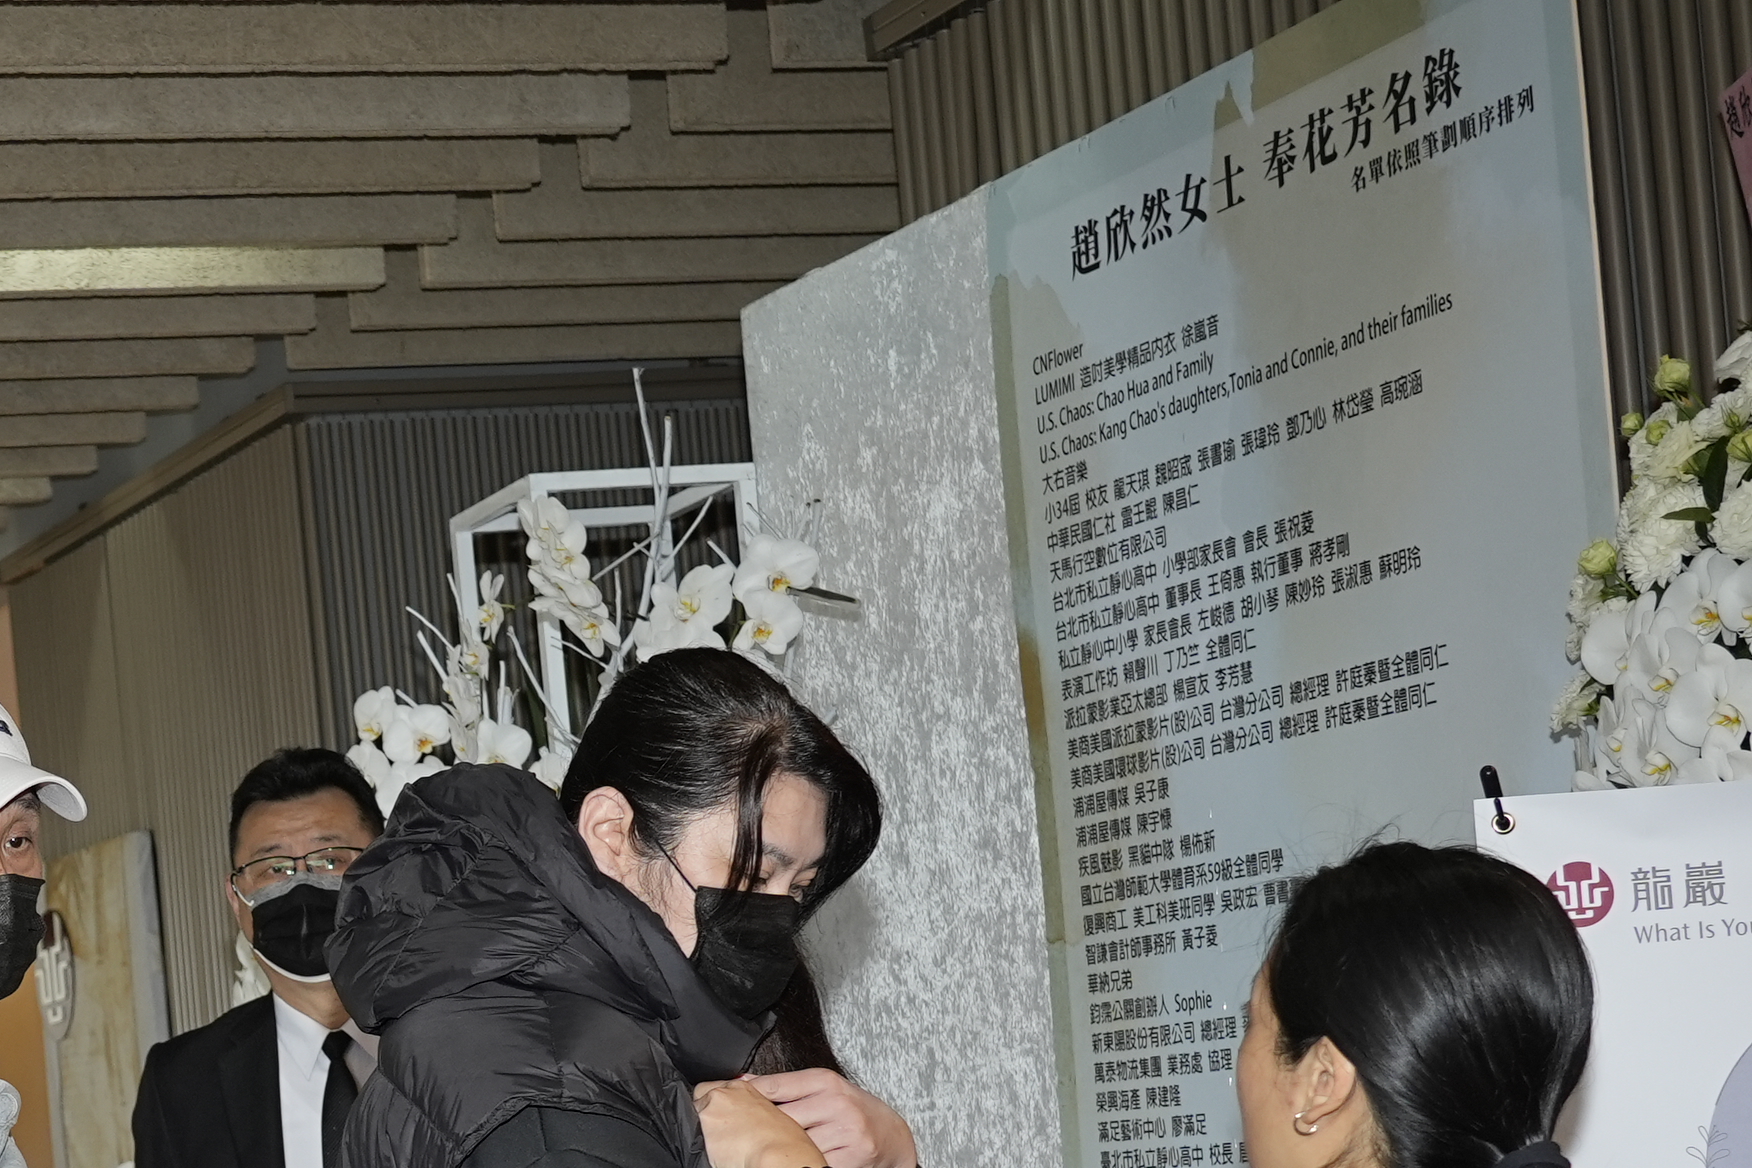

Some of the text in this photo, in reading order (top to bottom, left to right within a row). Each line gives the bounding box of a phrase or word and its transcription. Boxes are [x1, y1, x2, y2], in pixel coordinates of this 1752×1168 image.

[1070, 47, 1462, 280] 趙欣然女士 奉花芳名錄
[1351, 84, 1534, 192] 名單依照筆劃順序排列
[1032, 343, 1083, 375] CNFlower
[1039, 441, 1060, 464] U.S.
[1061, 431, 1097, 455] Chaos:
[1098, 419, 1127, 442] Kang
[1128, 400, 1166, 430] Chao's
[1265, 351, 1288, 380] and
[1290, 337, 1338, 369] Connie,
[1340, 321, 1364, 350] and
[1366, 311, 1398, 340] their
[1400, 292, 1452, 327] families
[1034, 372, 1075, 405] LUMIMI
[1036, 350, 1213, 434] U.S. Chaos: Chao Hua and Family
[1044, 492, 1080, 524] 小34屆
[1084, 484, 1109, 510] 校友
[1112, 467, 1150, 500] 龍天琪
[1196, 437, 1235, 471] 張書瑜
[1285, 405, 1326, 441] 鄧乃心
[1046, 511, 1116, 553] 中華民國仁社
[1162, 483, 1200, 515] 陳昌仁
[1049, 525, 1167, 583] 天馬行空數位有限公司
[1052, 509, 1314, 612] 台北市私立靜心高中 小學部家長會 會長 張祝菱
[1055, 592, 1159, 642] 台北市私立靜心高中
[1164, 577, 1202, 609] 董事長
[1250, 546, 1303, 584] 執行董事
[1057, 627, 1138, 671] 私立靜心中小學
[1143, 612, 1192, 646] 家長會長
[1239, 586, 1279, 619] 胡小琴
[1284, 573, 1325, 607] 陳妙玲
[1330, 559, 1373, 593] 張淑惠
[1378, 545, 1421, 580] 蘇明玲
[1060, 627, 1256, 701] 表演工作坊 賴聲川 丁乃竺 全體同仁
[1063, 660, 1253, 729] 派拉蒙影業亞太總部 楊宣友 李芳慧
[1066, 702, 1214, 760] 美商美國派拉蒙影片(股)公司
[1219, 684, 1284, 722] 台灣分公司
[1289, 672, 1330, 704] 總經理
[1070, 736, 1205, 789] 美商美國環球影片(股)公司
[1209, 719, 1273, 756] 台灣分公司
[1278, 708, 1319, 740] 總經理
[1072, 776, 1169, 818] 浦浦屋傳媒 吳子康
[1075, 815, 1132, 847] 浦浦屋傳媒
[1127, 838, 1174, 867] 黑貓中隊
[1080, 847, 1283, 906] 國立台灣師範大學體育系59級全體同學
[1630, 861, 1729, 912] 龍巖
[1082, 879, 1298, 936] 復興商工 美工科美班同學 吳政宏 曹書
[1633, 918, 1752, 943] What Is Yo
[1181, 924, 1218, 951] 黃子菱
[1086, 968, 1132, 994] 華納兄弟
[1174, 989, 1212, 1016] Sophie
[1091, 1021, 1195, 1054] 新東陽股份有限公司
[1200, 1015, 1237, 1041] 總經理
[1093, 1047, 1233, 1083] 萬泰物流集團 業務處 協理
[1095, 1084, 1181, 1112] 榮興海產 陳建隆
[1097, 1112, 1207, 1142] 滿足藝術中心 廖滿足
[1208, 1142, 1233, 1165] 校長
